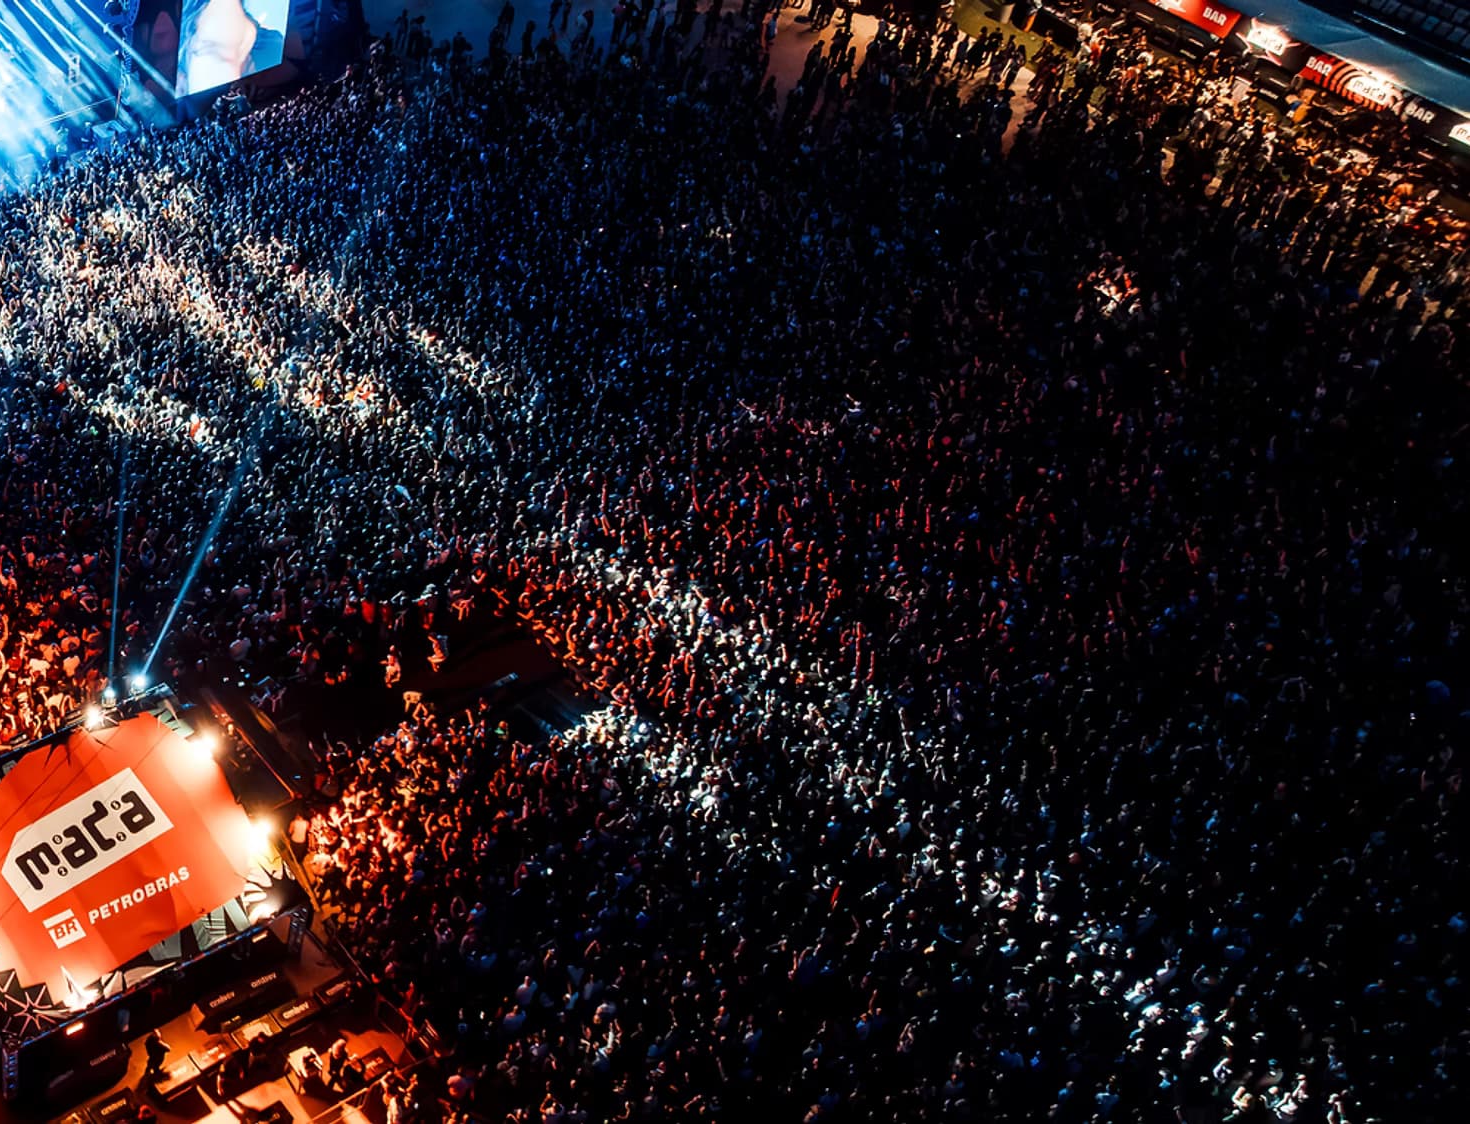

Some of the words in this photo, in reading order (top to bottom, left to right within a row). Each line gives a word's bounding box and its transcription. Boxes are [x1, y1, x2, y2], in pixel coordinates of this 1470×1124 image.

[1202, 7, 1228, 27] BAR
[1306, 56, 1333, 77] BAR
[1405, 103, 1435, 124] BAR
[88, 866, 190, 924] PETROBRAS
